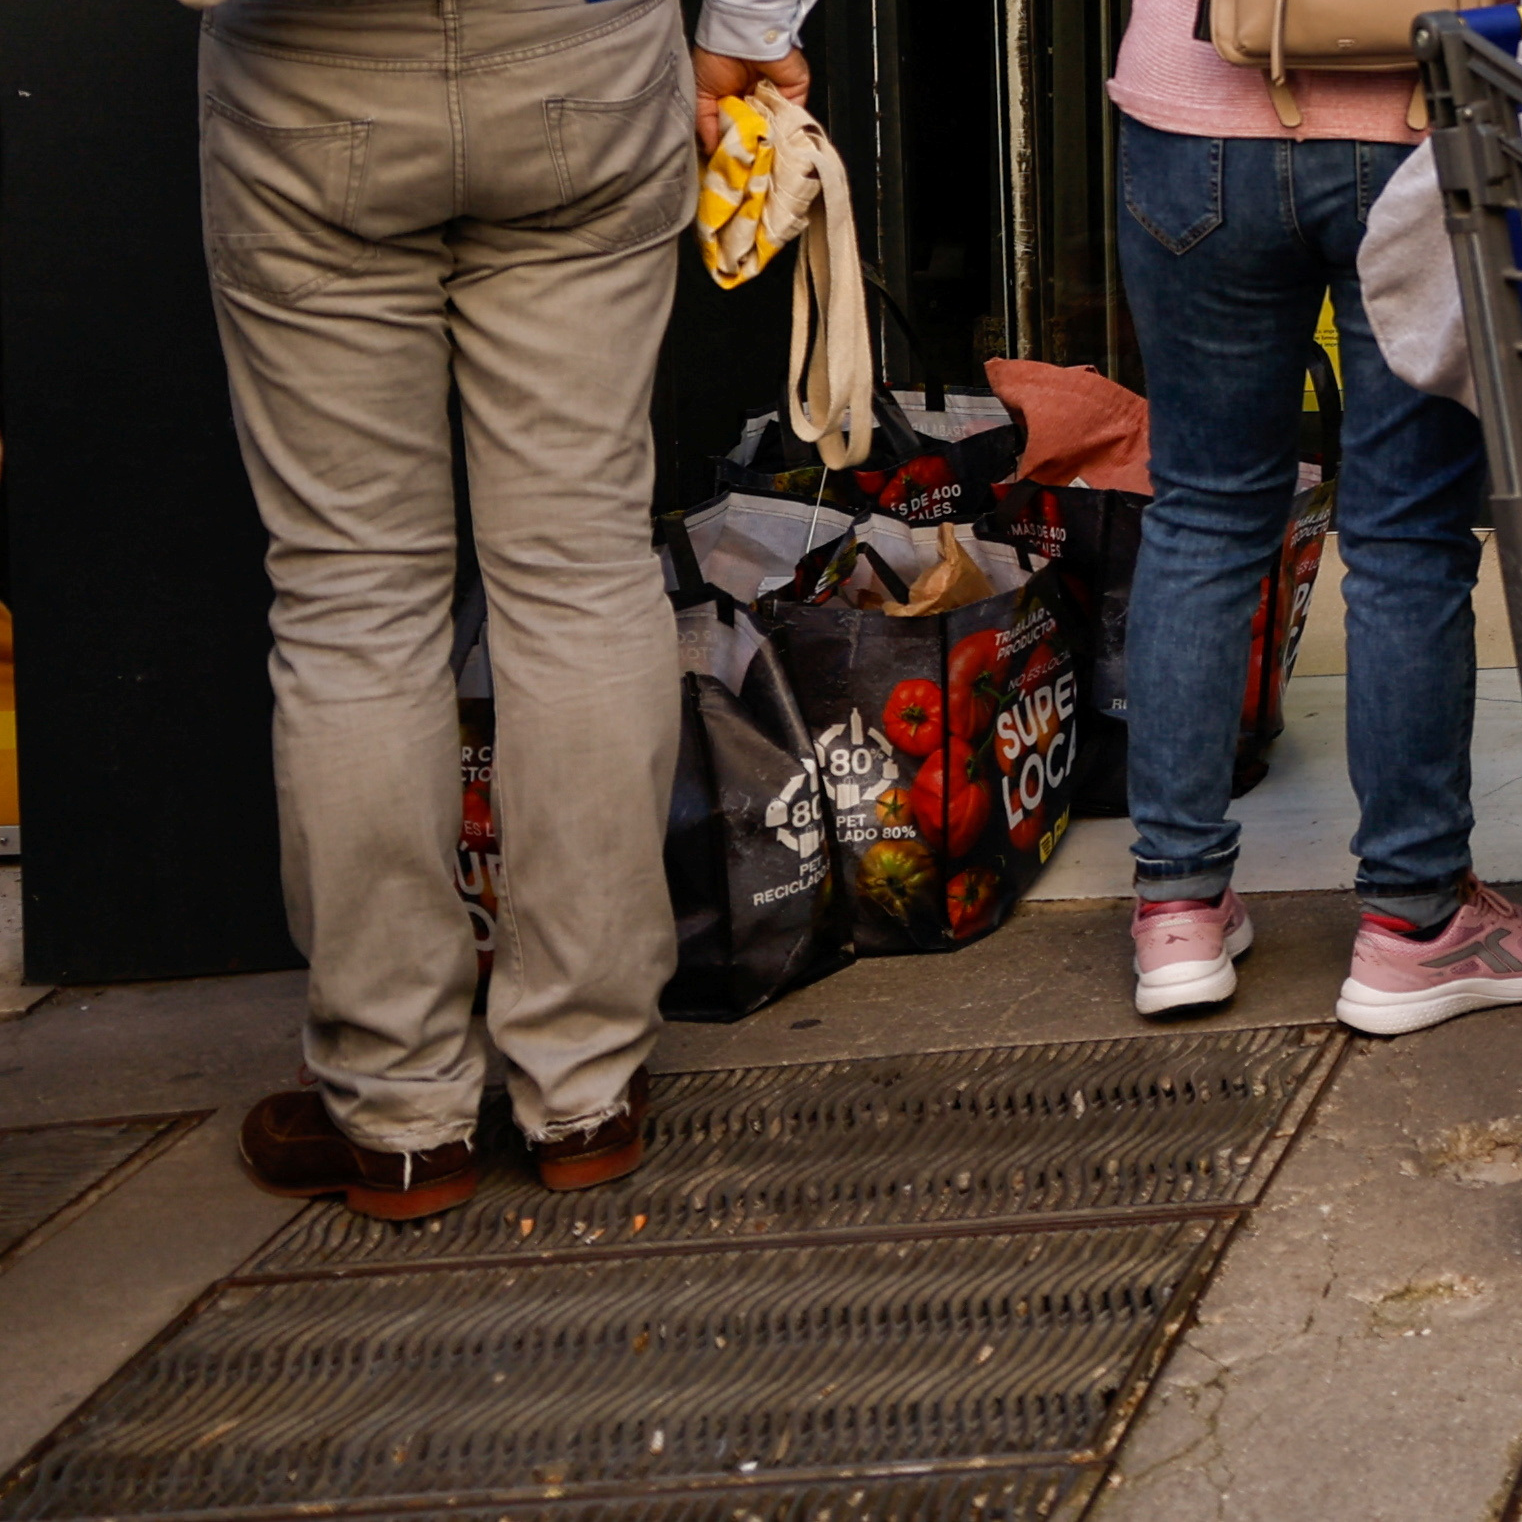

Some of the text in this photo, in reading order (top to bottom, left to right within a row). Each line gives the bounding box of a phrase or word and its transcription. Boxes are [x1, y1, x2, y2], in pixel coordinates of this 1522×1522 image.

[910, 492, 930, 512] DE
[931, 484, 962, 501] 400
[1036, 525, 1049, 539] DE
[1049, 526, 1067, 542] 400
[995, 606, 1045, 646] TRABAJAR
[1008, 673, 1025, 692] NO
[1026, 665, 1041, 682] ES
[836, 813, 866, 828] PET
[881, 825, 917, 839] 80%
[799, 855, 823, 877] PET
